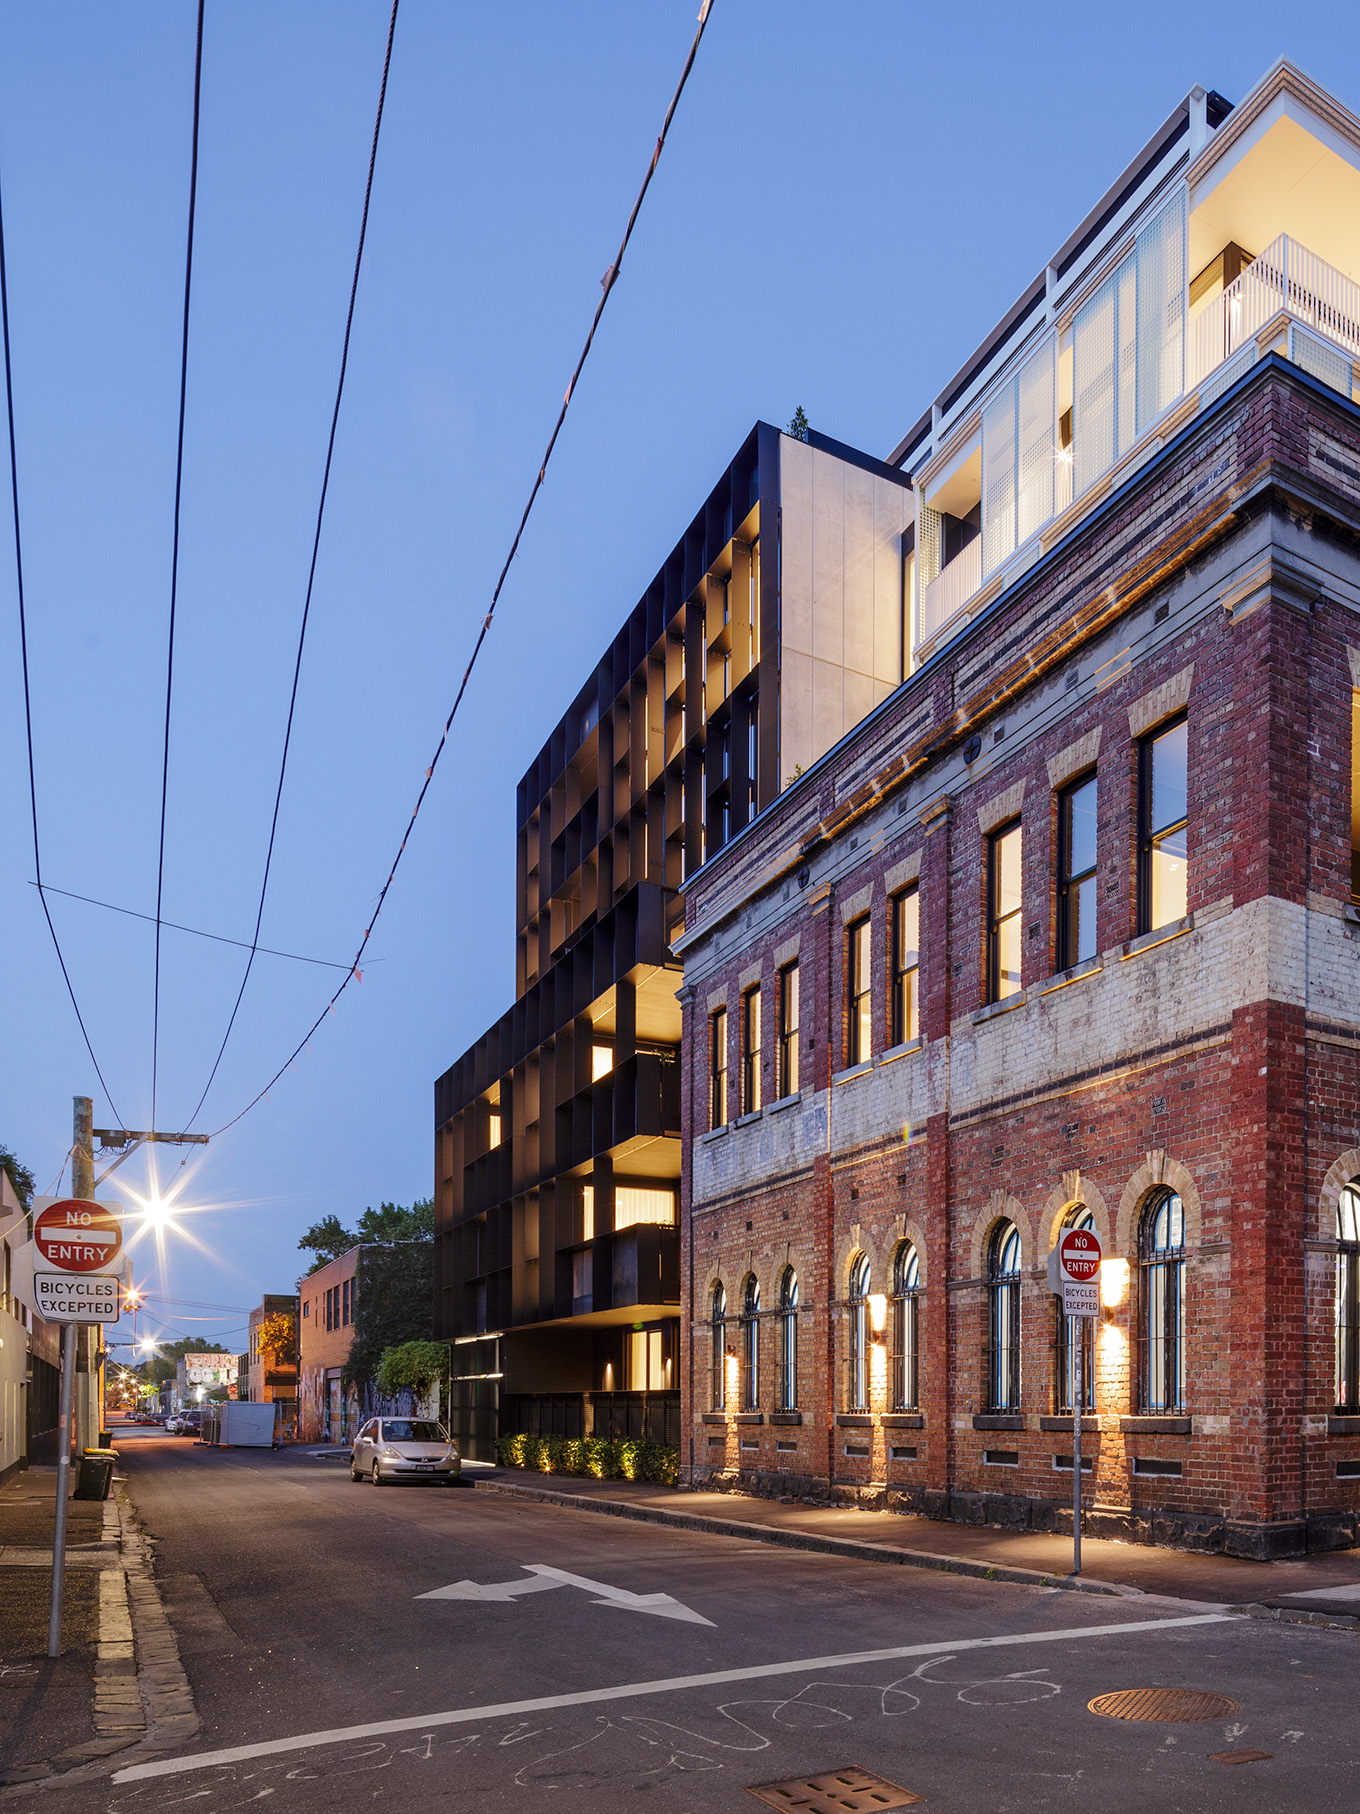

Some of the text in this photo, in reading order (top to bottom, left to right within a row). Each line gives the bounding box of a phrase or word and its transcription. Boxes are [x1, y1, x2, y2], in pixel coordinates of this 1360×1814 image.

[66, 1211, 92, 1226] NO
[1075, 1238, 1088, 1249] NO
[48, 1244, 109, 1261] ENTRY
[1067, 1261, 1096, 1273] ENTRY
[40, 1282, 113, 1296] BICYCLES
[1065, 1288, 1097, 1298] BICYCLES
[41, 1300, 113, 1314] EXCEPTED
[1065, 1301, 1098, 1311] EXCEPTED
